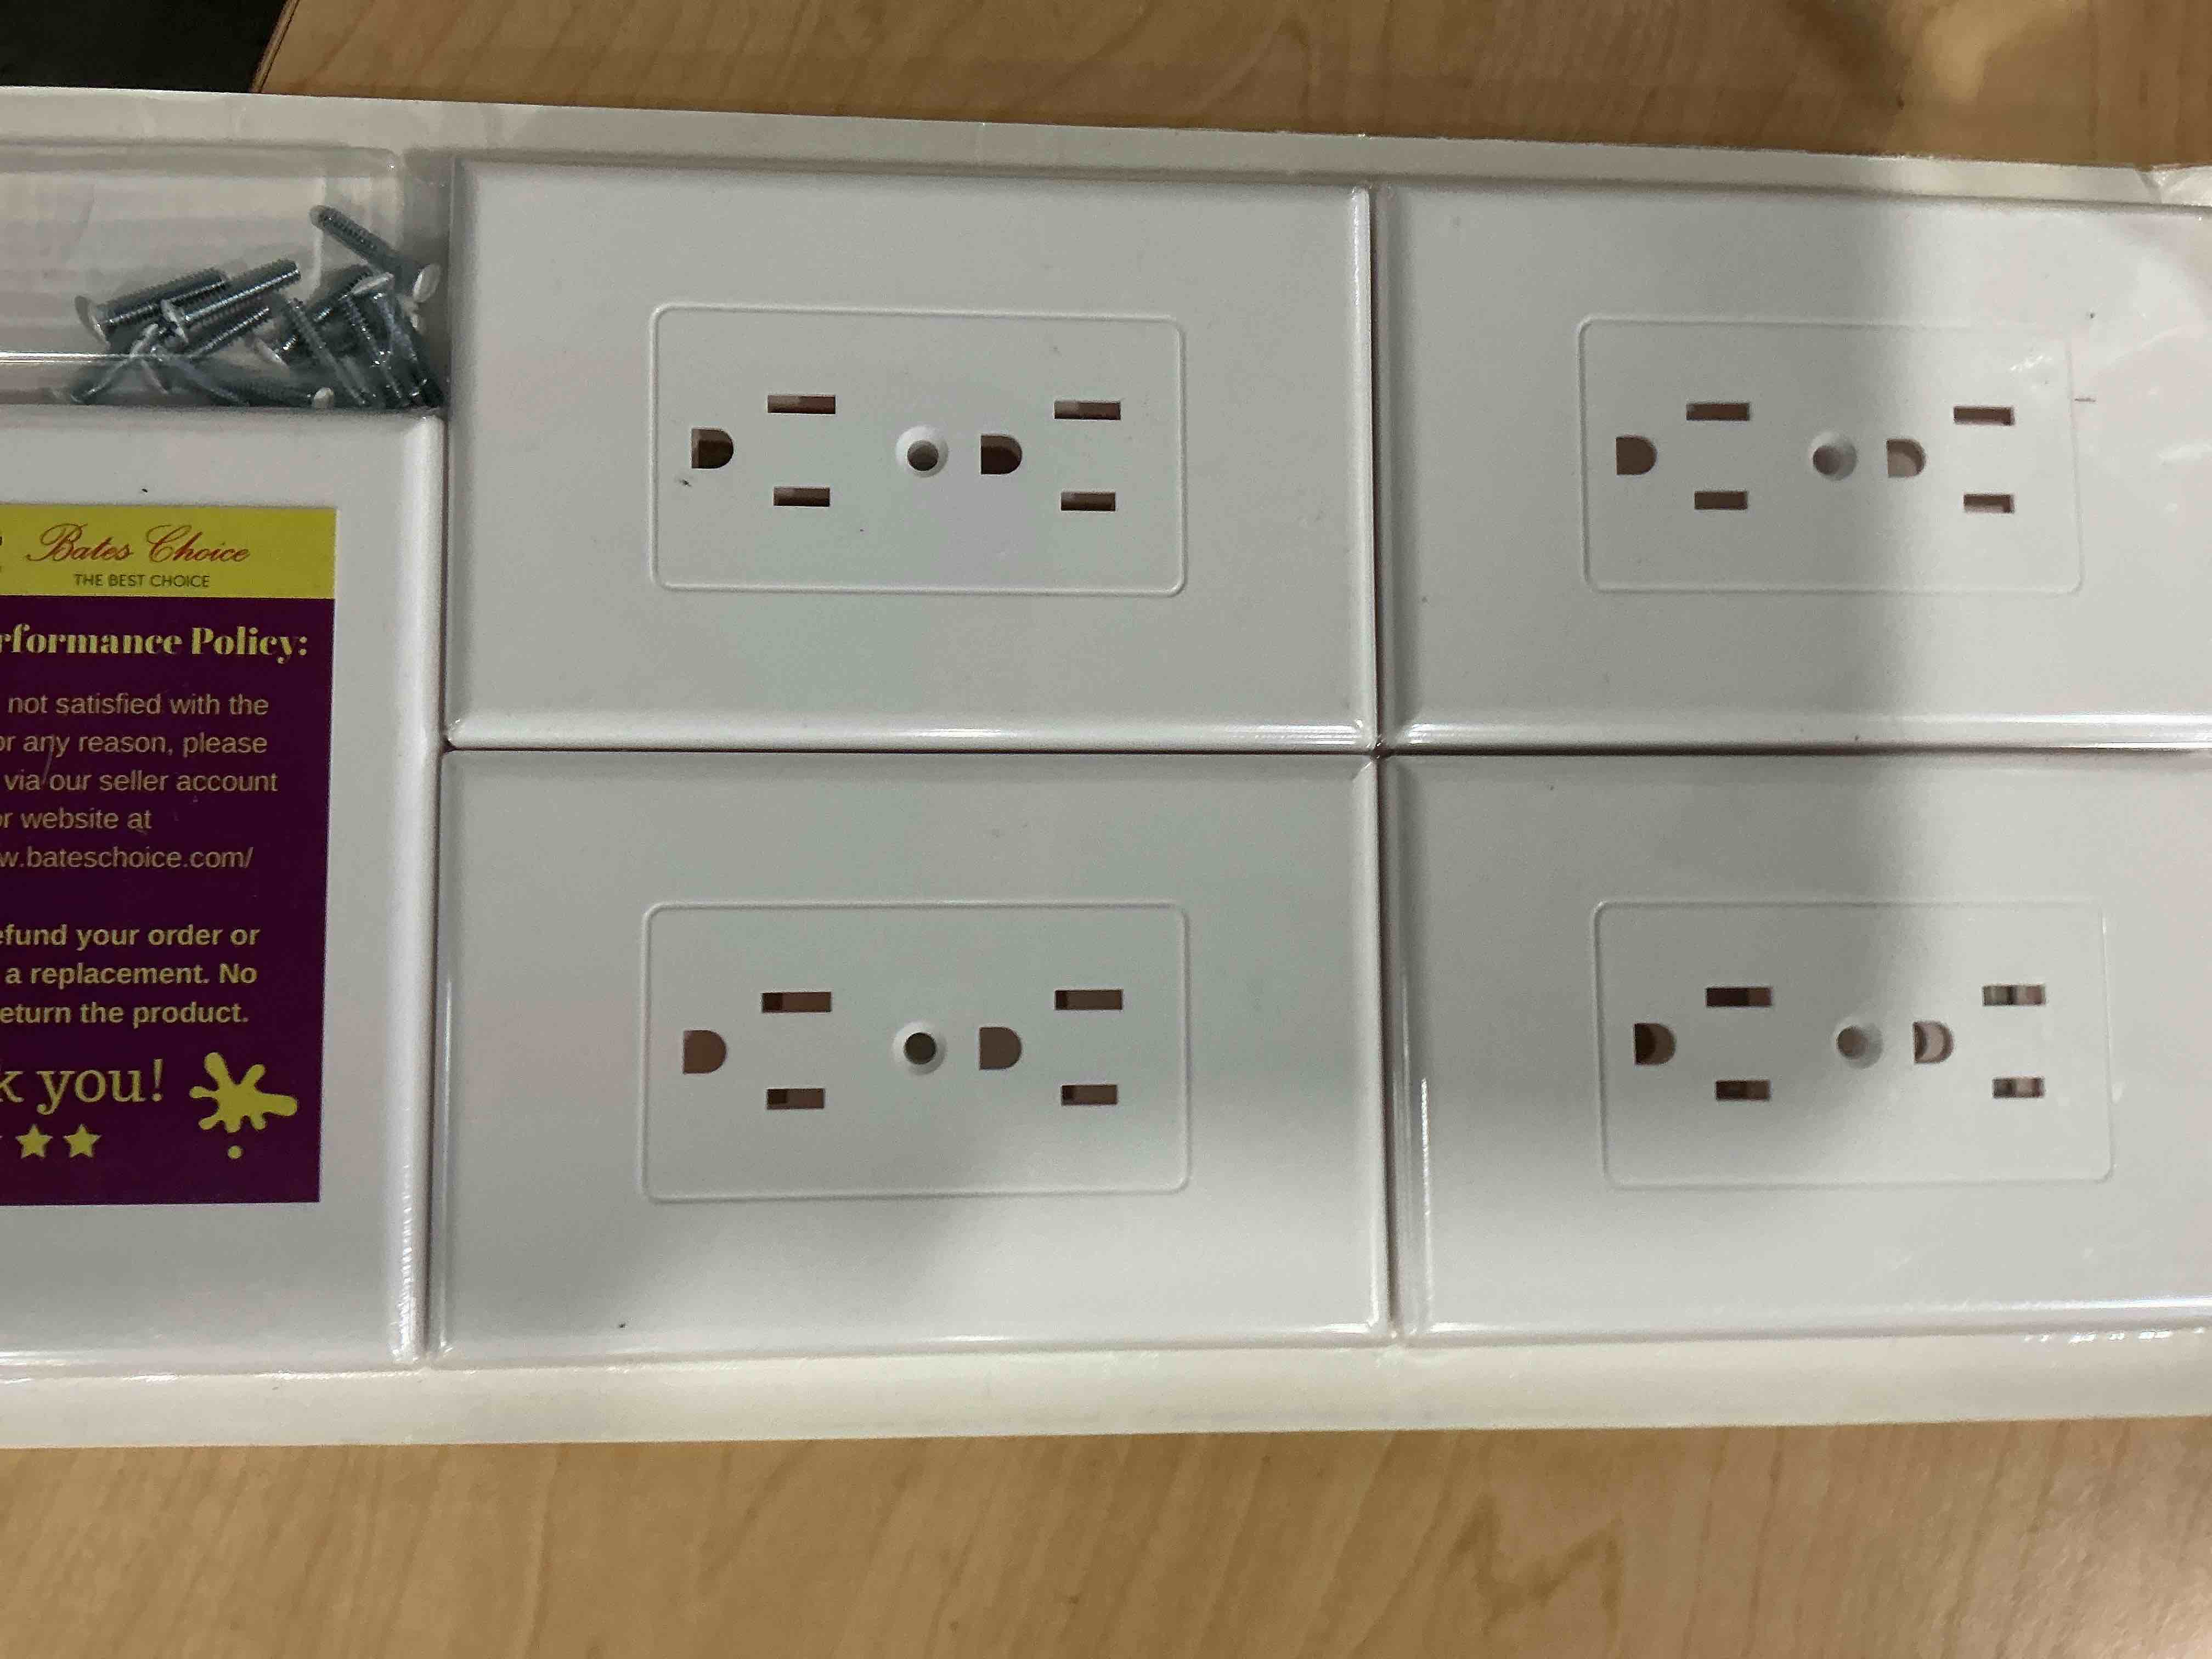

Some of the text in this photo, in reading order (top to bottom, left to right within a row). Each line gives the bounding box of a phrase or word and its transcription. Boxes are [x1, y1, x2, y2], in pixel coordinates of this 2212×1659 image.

[26, 523, 250, 563] Bates Choice
[75, 573, 210, 588] THE BEST CHOICE
[191, 626, 308, 664] Policy:
[8, 693, 269, 715] not satisfied with the
[23, 736, 70, 758] any
[78, 736, 172, 756] reason,
[183, 732, 267, 757] please
[5, 769, 278, 792] via our seller account
[21, 808, 119, 829] website
[127, 810, 151, 829] at
[0, 924, 260, 951] fund your order or
[5, 962, 257, 990] a replacement. No
[0, 1001, 248, 1029] eturn the product.
[36, 1058, 163, 1115] you!
